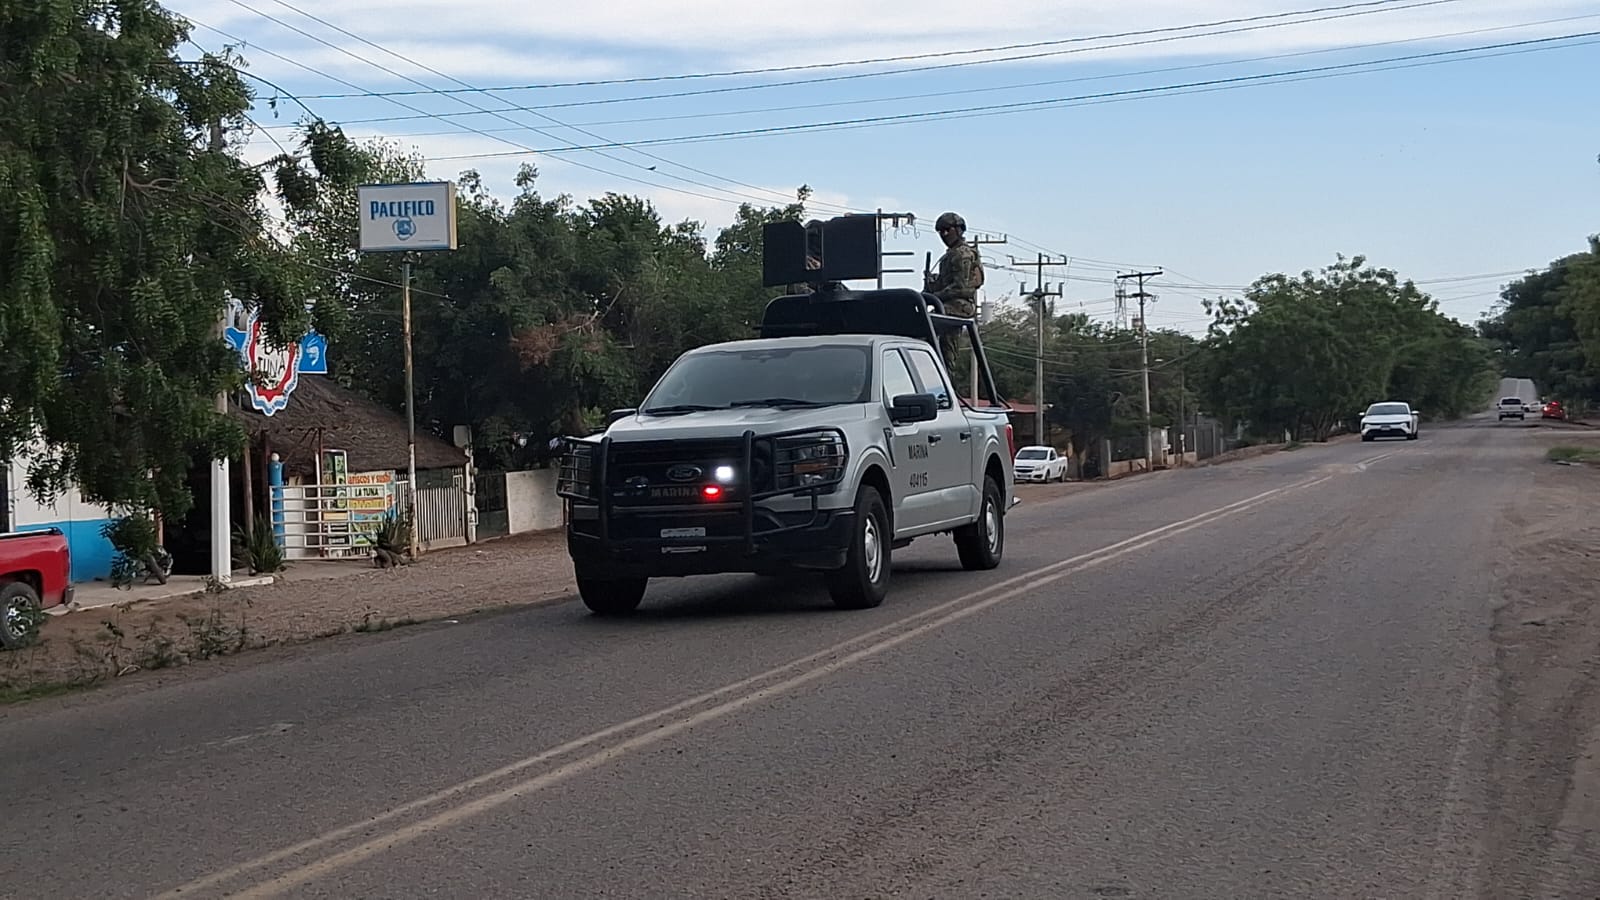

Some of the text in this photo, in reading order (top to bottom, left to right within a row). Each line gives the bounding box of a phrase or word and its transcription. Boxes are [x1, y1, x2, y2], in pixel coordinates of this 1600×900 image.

[370, 200, 434, 220] PACIFICO
[907, 444, 929, 460] MARINA
[355, 487, 379, 497] LA TUNA
[651, 487, 700, 497] MARINA
